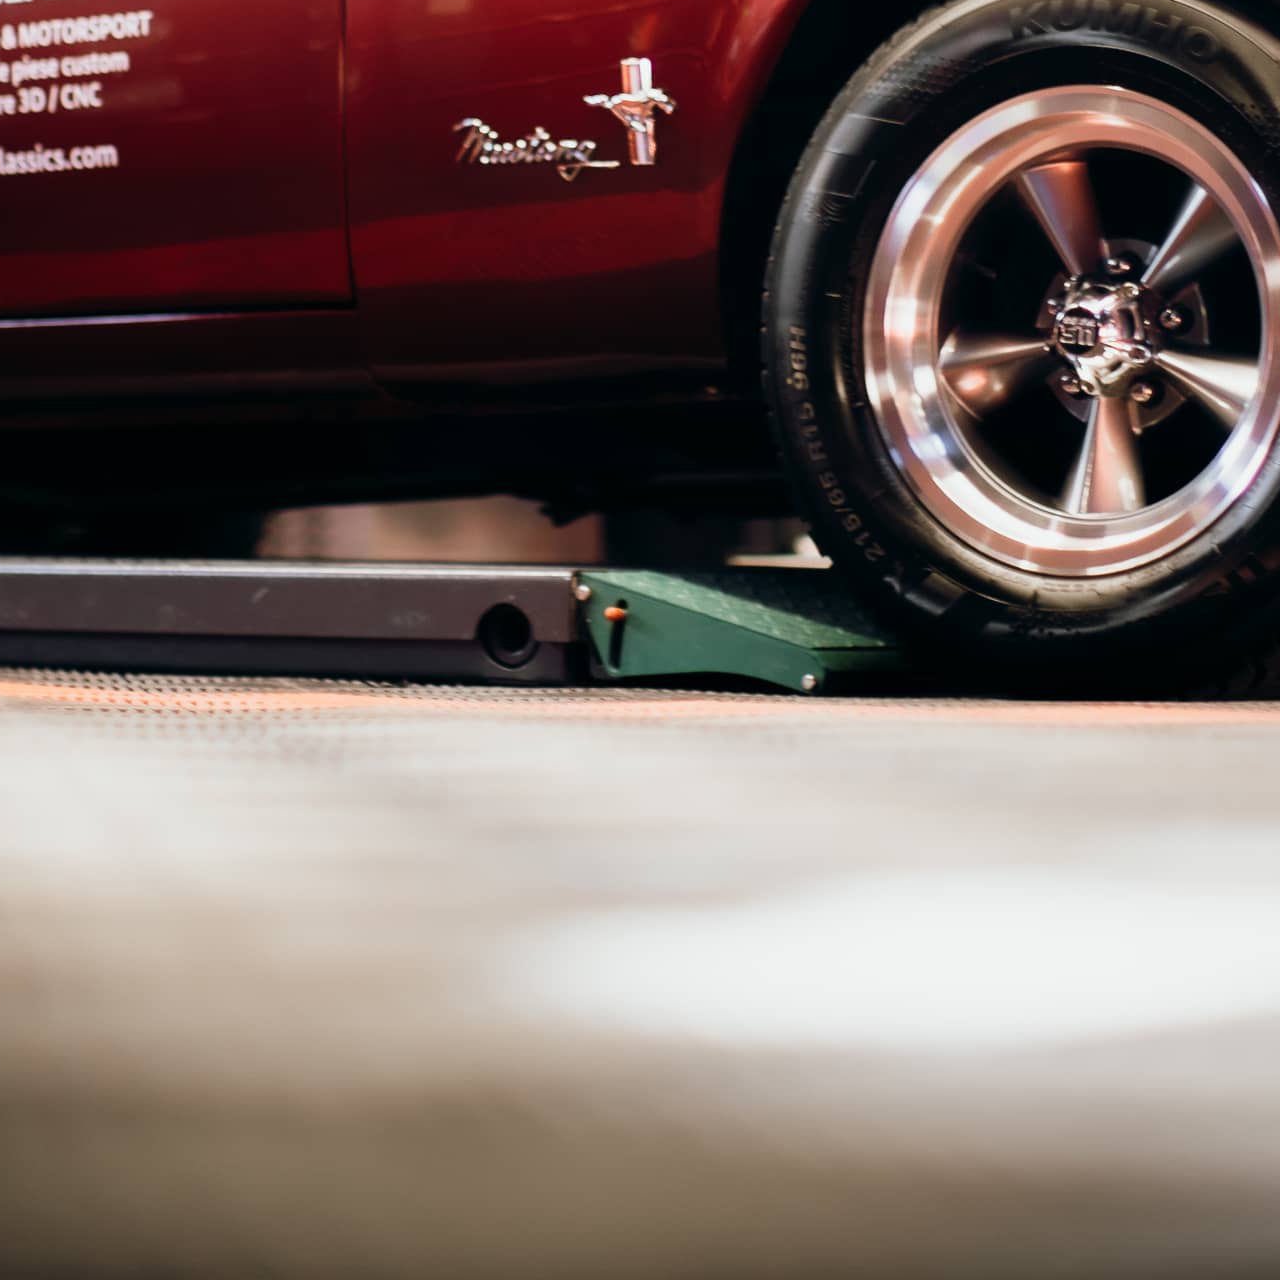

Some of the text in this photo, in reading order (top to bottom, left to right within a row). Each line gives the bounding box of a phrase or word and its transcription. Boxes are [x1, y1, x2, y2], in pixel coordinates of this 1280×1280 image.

[1, 23, 17, 51] &
[18, 10, 154, 48] MOTORSPORT
[11, 54, 60, 88] piese
[60, 51, 131, 78] custom
[18, 85, 46, 114] 3D
[47, 84, 59, 114] /
[59, 80, 104, 110] CNC
